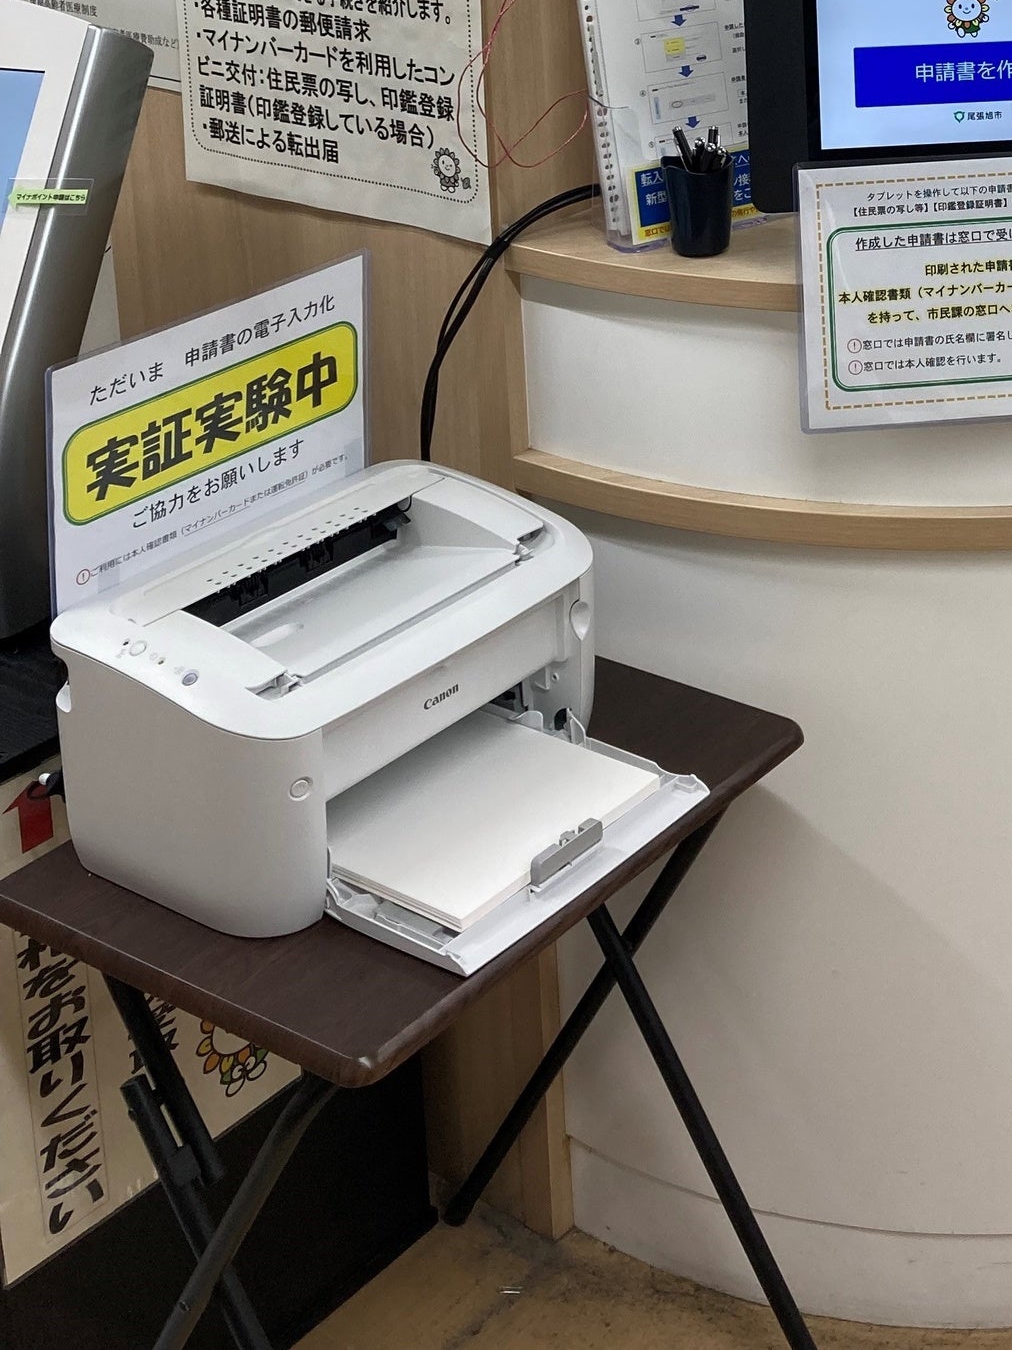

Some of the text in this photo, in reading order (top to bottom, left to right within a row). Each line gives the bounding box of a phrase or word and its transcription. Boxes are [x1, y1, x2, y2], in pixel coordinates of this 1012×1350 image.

[197, 56, 456, 122] ビニ交付：住民票の写し、印鑑登録
[199, 84, 435, 149] 証明書（印鑑登録している場合）
[184, 294, 335, 368] 申請書の電子入力化
[862, 353, 1003, 372] 窓口では本人確認を行います。
[89, 362, 164, 405] ただいま
[85, 351, 340, 501] 実証実験中
[132, 439, 305, 528] ご協力をお願いします
[423, 682, 460, 711] Canon
